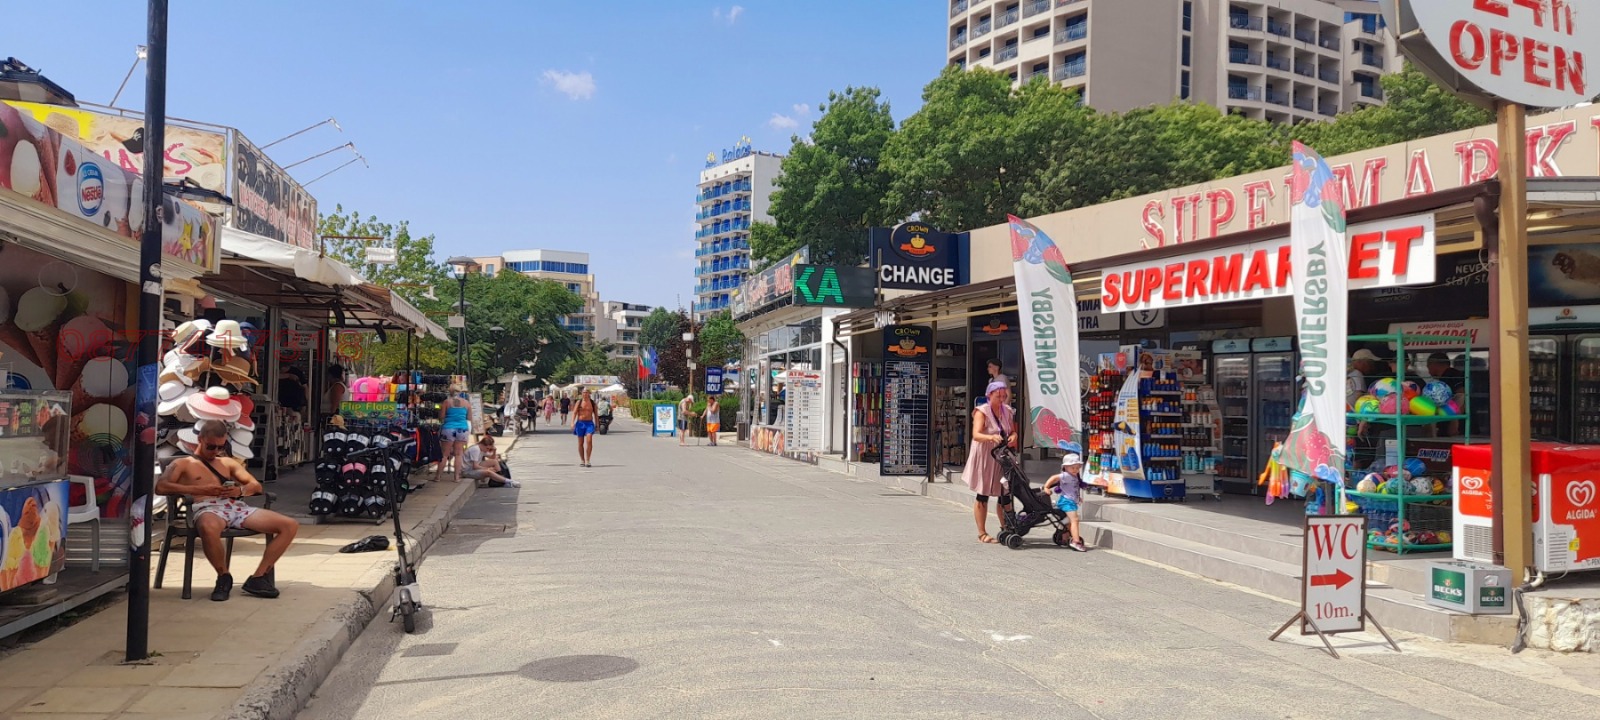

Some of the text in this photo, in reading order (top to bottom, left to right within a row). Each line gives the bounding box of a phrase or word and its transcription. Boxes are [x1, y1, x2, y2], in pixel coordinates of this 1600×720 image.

[1448, 19, 1585, 96] OPEN
[1140, 114, 1600, 251] SUPEMARK
[881, 264, 955, 285] CHANGE
[1102, 225, 1424, 307] SUPERMARET
[707, 383, 721, 392] GOLF
[1419, 449, 1448, 459] SNICKERS
[1566, 509, 1596, 520] ALGIDA
[1312, 523, 1359, 561] WC
[1434, 584, 1463, 597] BECK'S
[1314, 602, 1354, 620] 10m.
